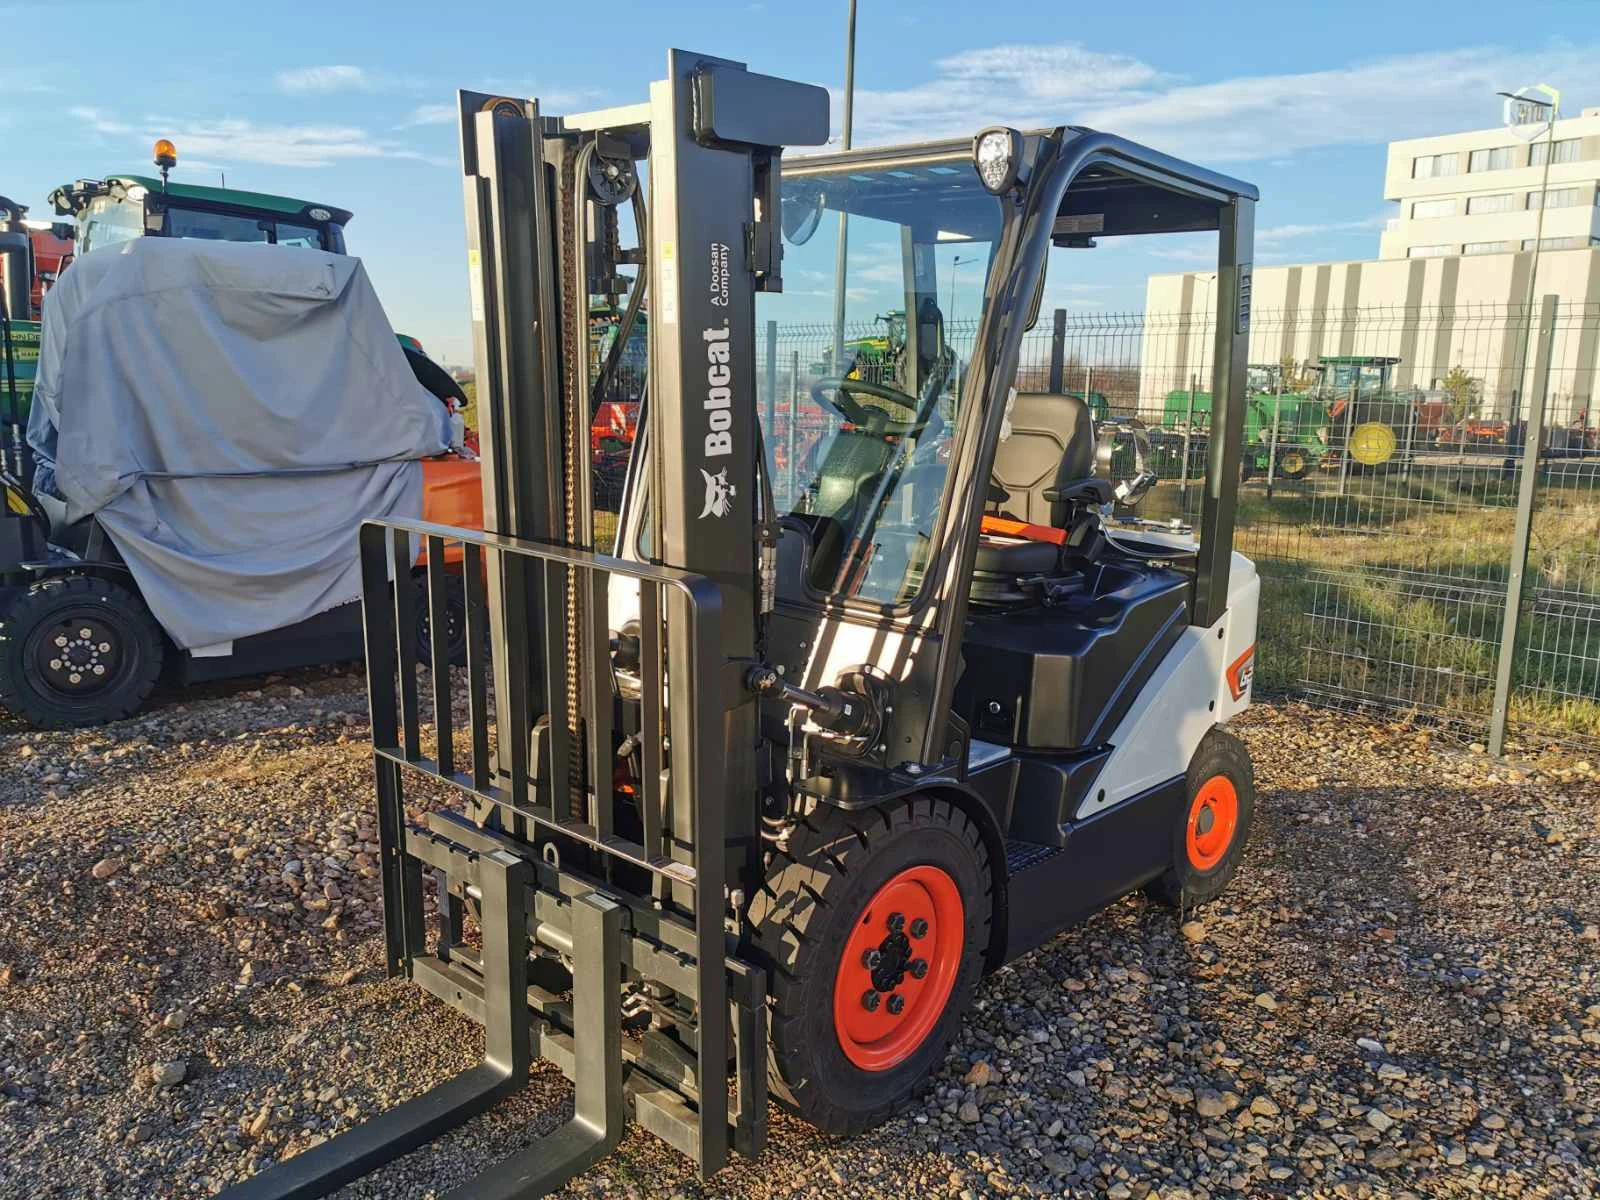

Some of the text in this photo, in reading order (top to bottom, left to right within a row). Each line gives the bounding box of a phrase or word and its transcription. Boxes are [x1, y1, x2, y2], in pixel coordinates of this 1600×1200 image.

[710, 243, 720, 306] A Doosan
[719, 244, 730, 306] Company
